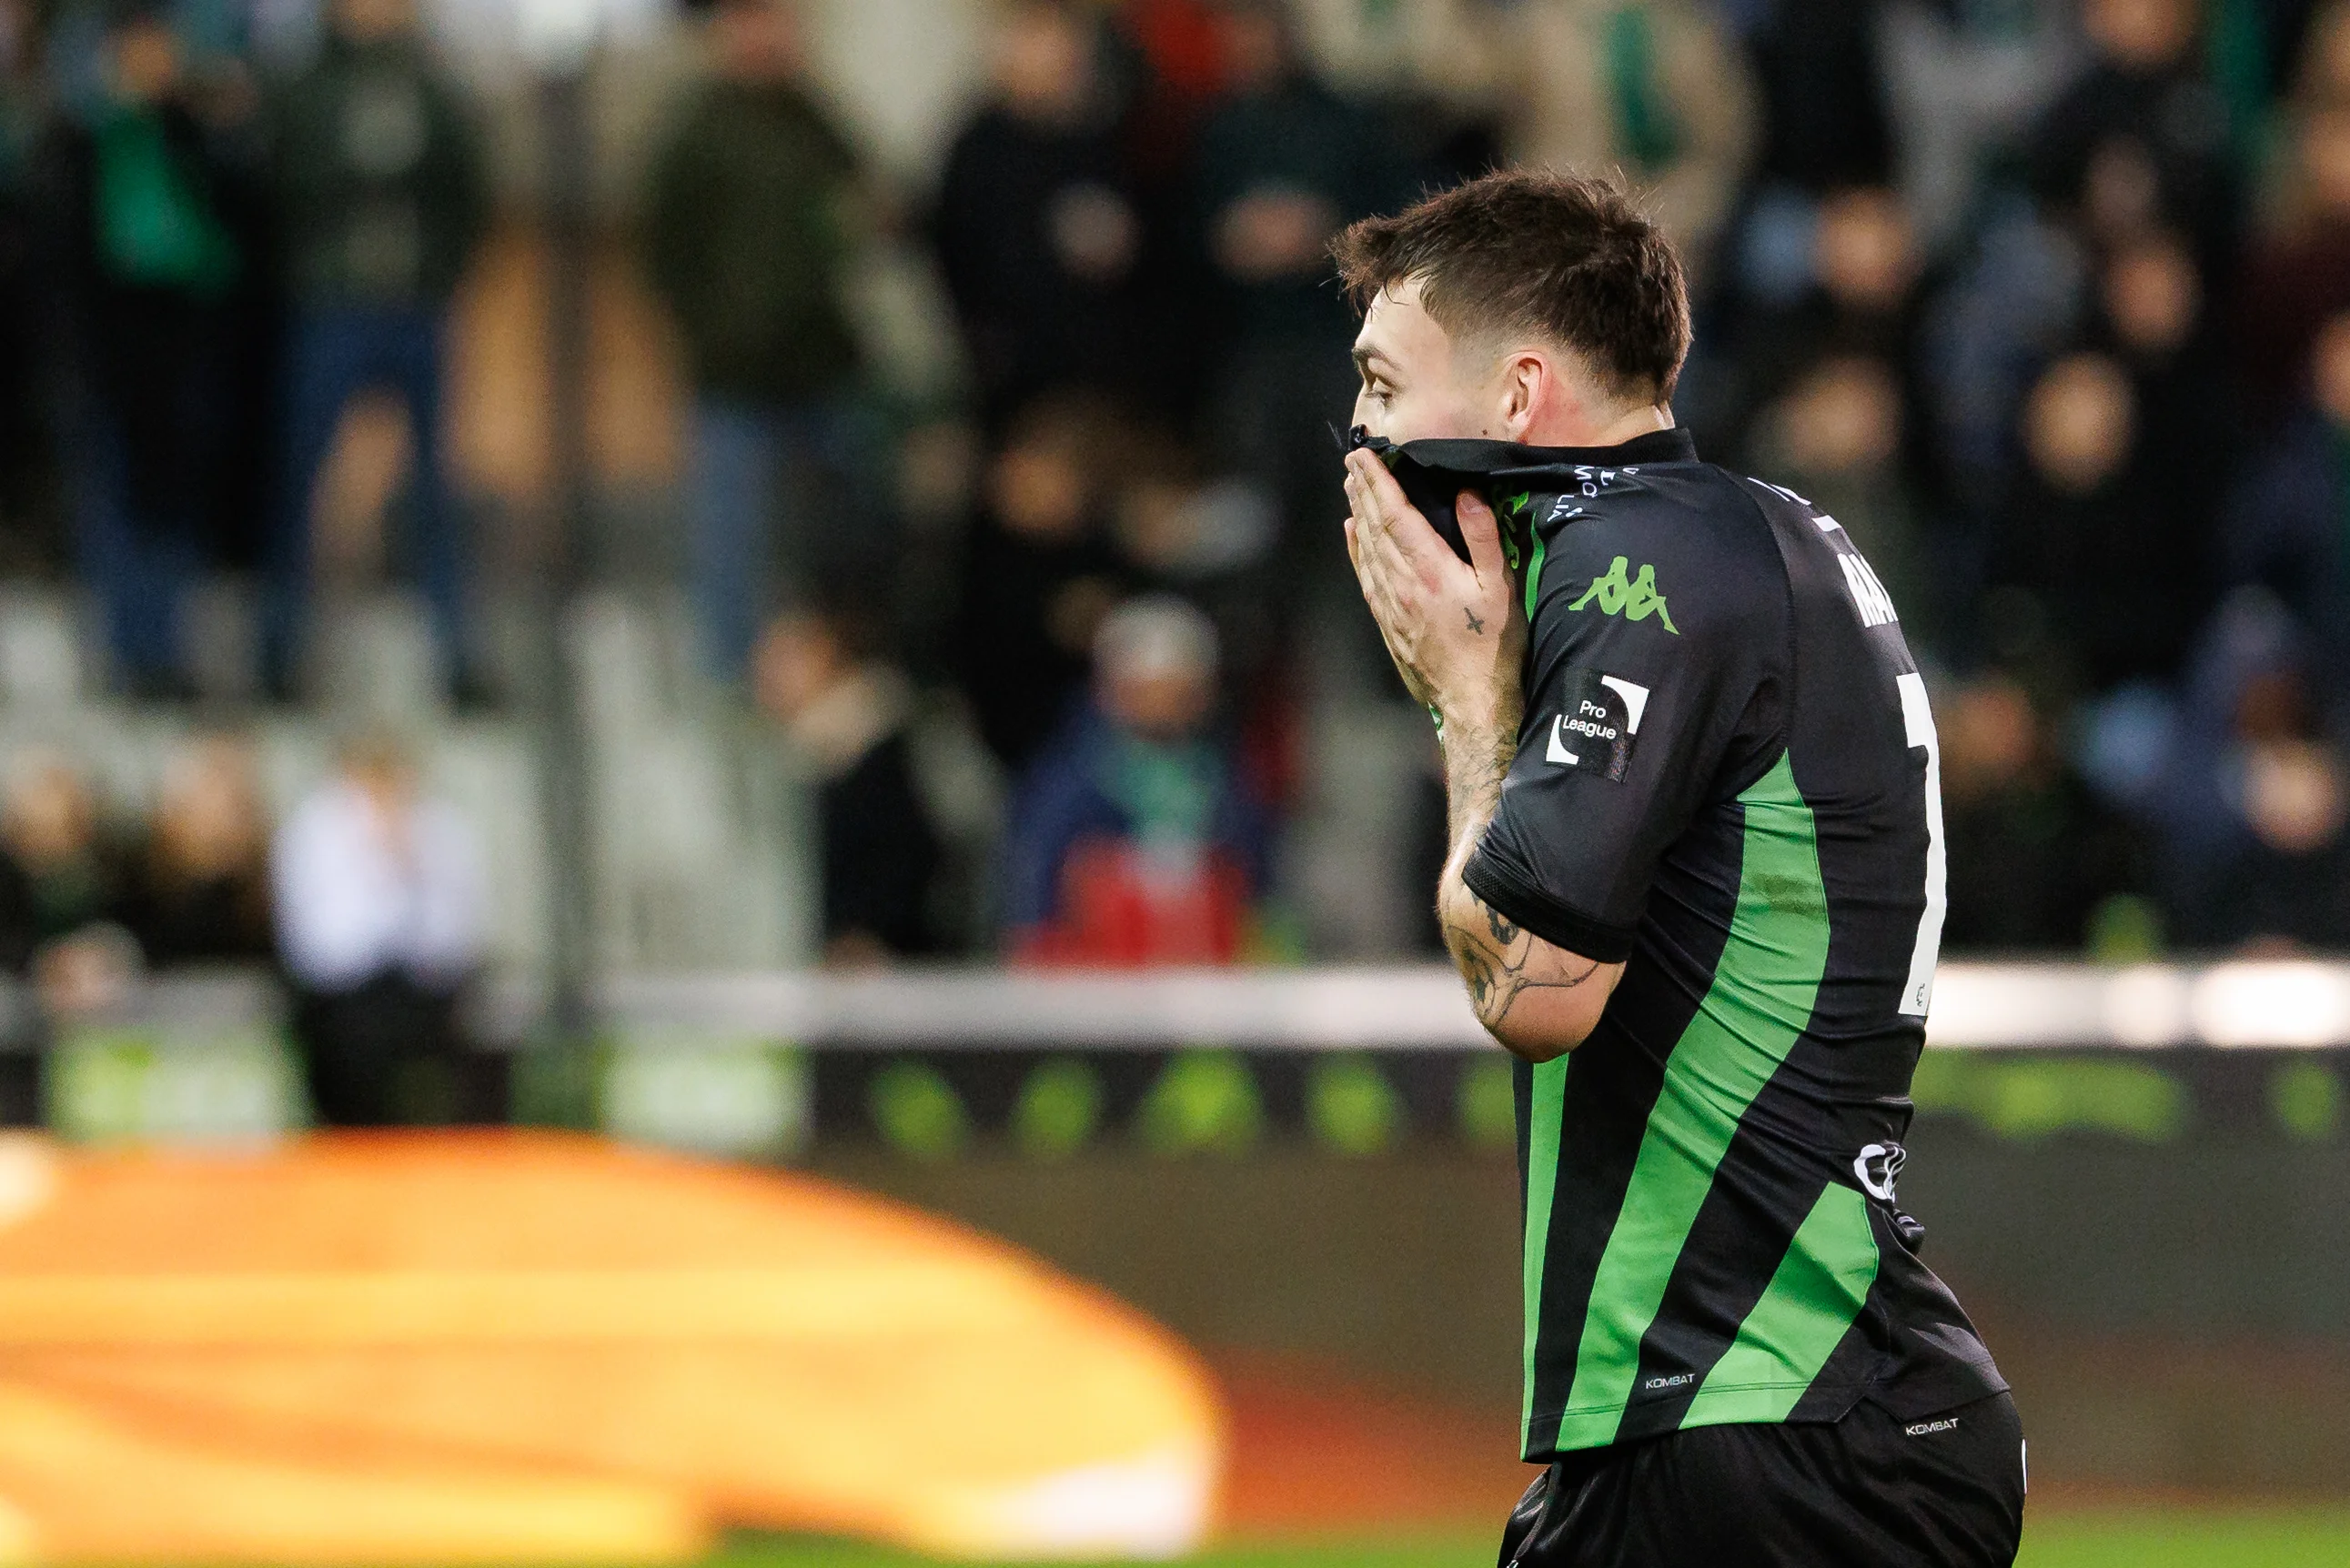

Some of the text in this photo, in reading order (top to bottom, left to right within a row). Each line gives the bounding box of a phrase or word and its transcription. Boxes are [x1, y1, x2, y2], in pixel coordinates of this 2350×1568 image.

[1579, 699, 1607, 719] Pro
[1562, 715, 1617, 739] League
[1646, 1373, 1695, 1389] KOMBAT
[1905, 1418, 1959, 1435] KOMBAT
